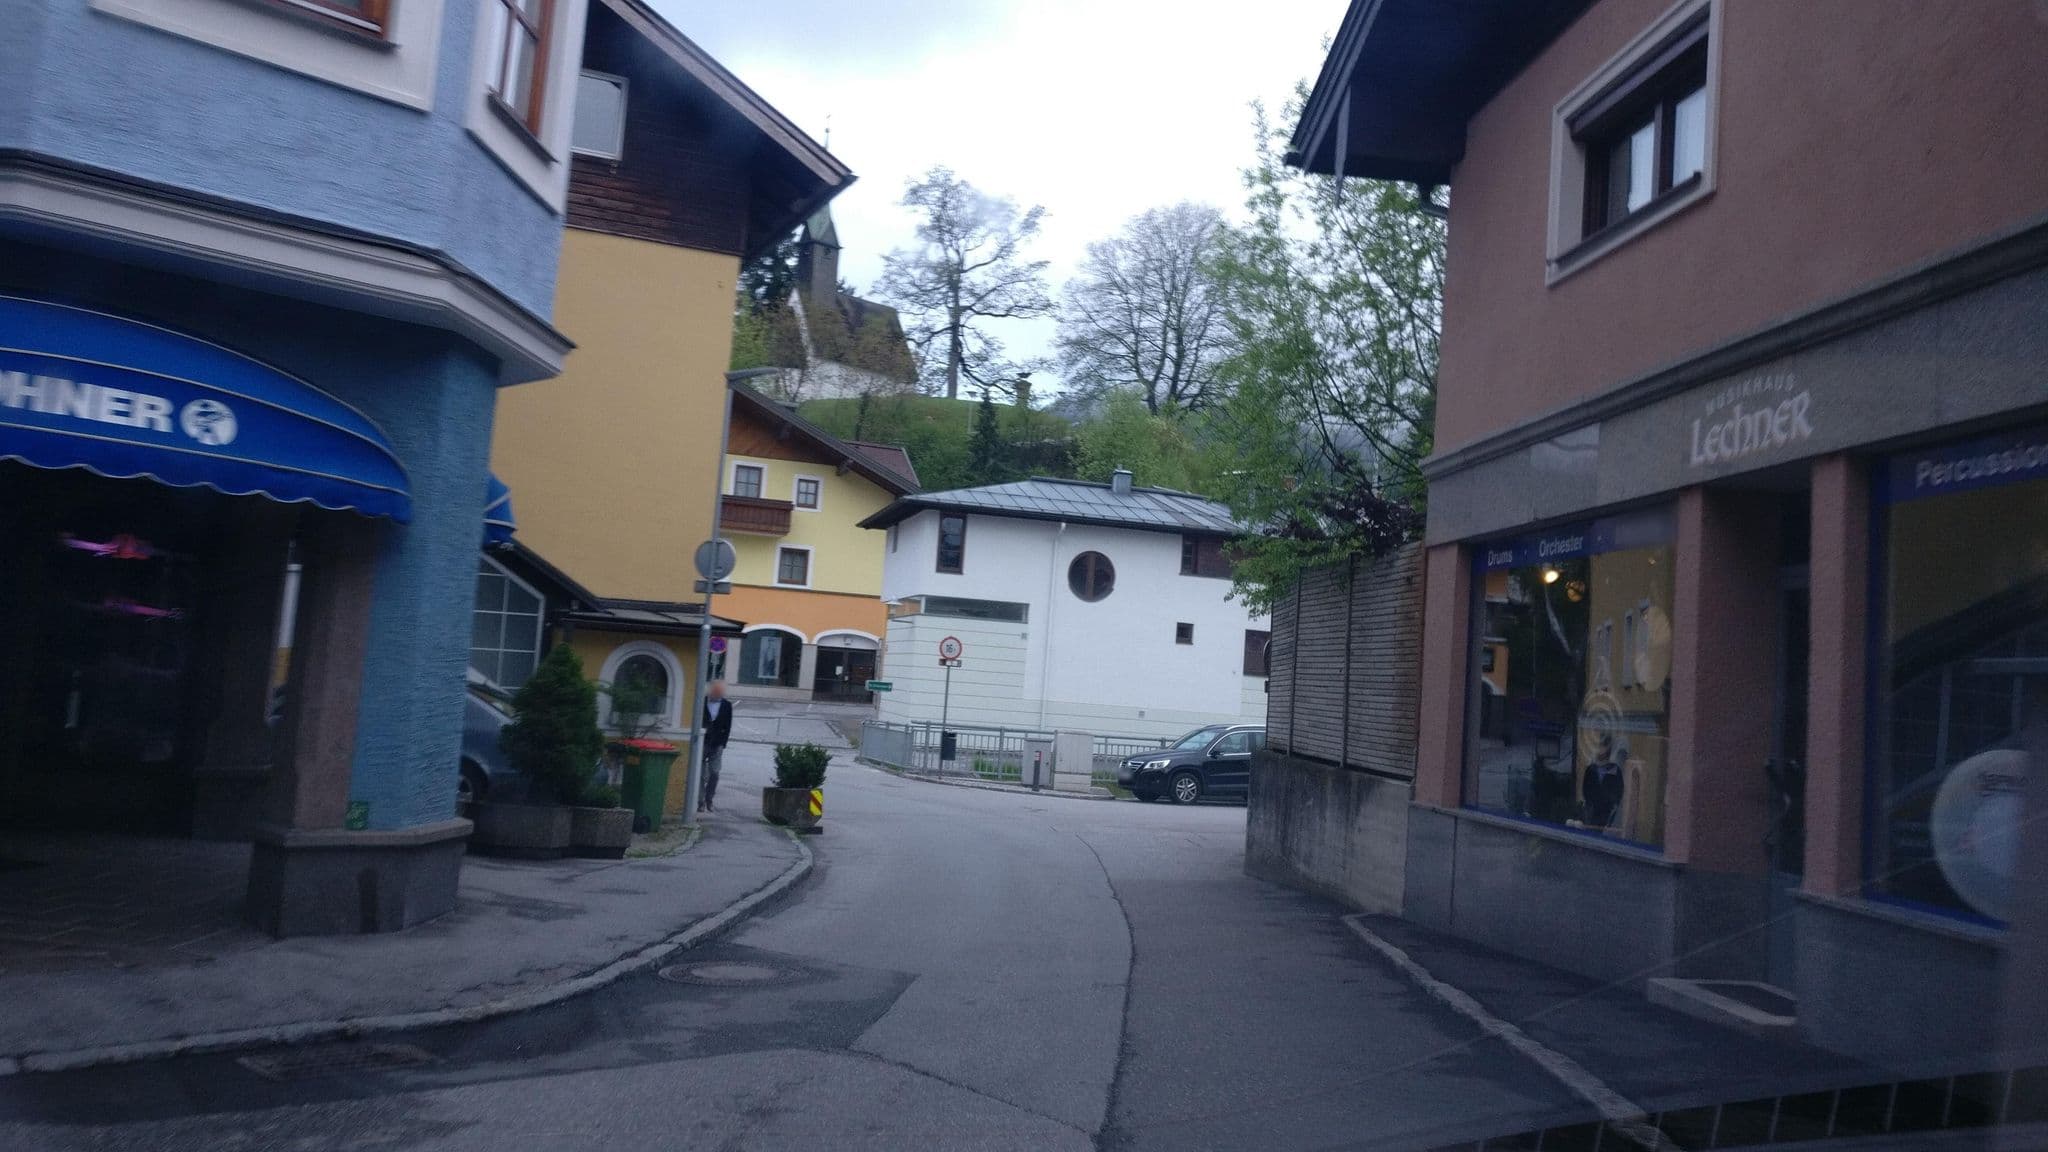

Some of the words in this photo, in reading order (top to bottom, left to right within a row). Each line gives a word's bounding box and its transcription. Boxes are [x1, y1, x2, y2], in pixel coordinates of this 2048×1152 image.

[0, 369, 174, 433] HNER
[1488, 550, 1513, 567] Drums
[1539, 535, 1584, 558] Orchester
